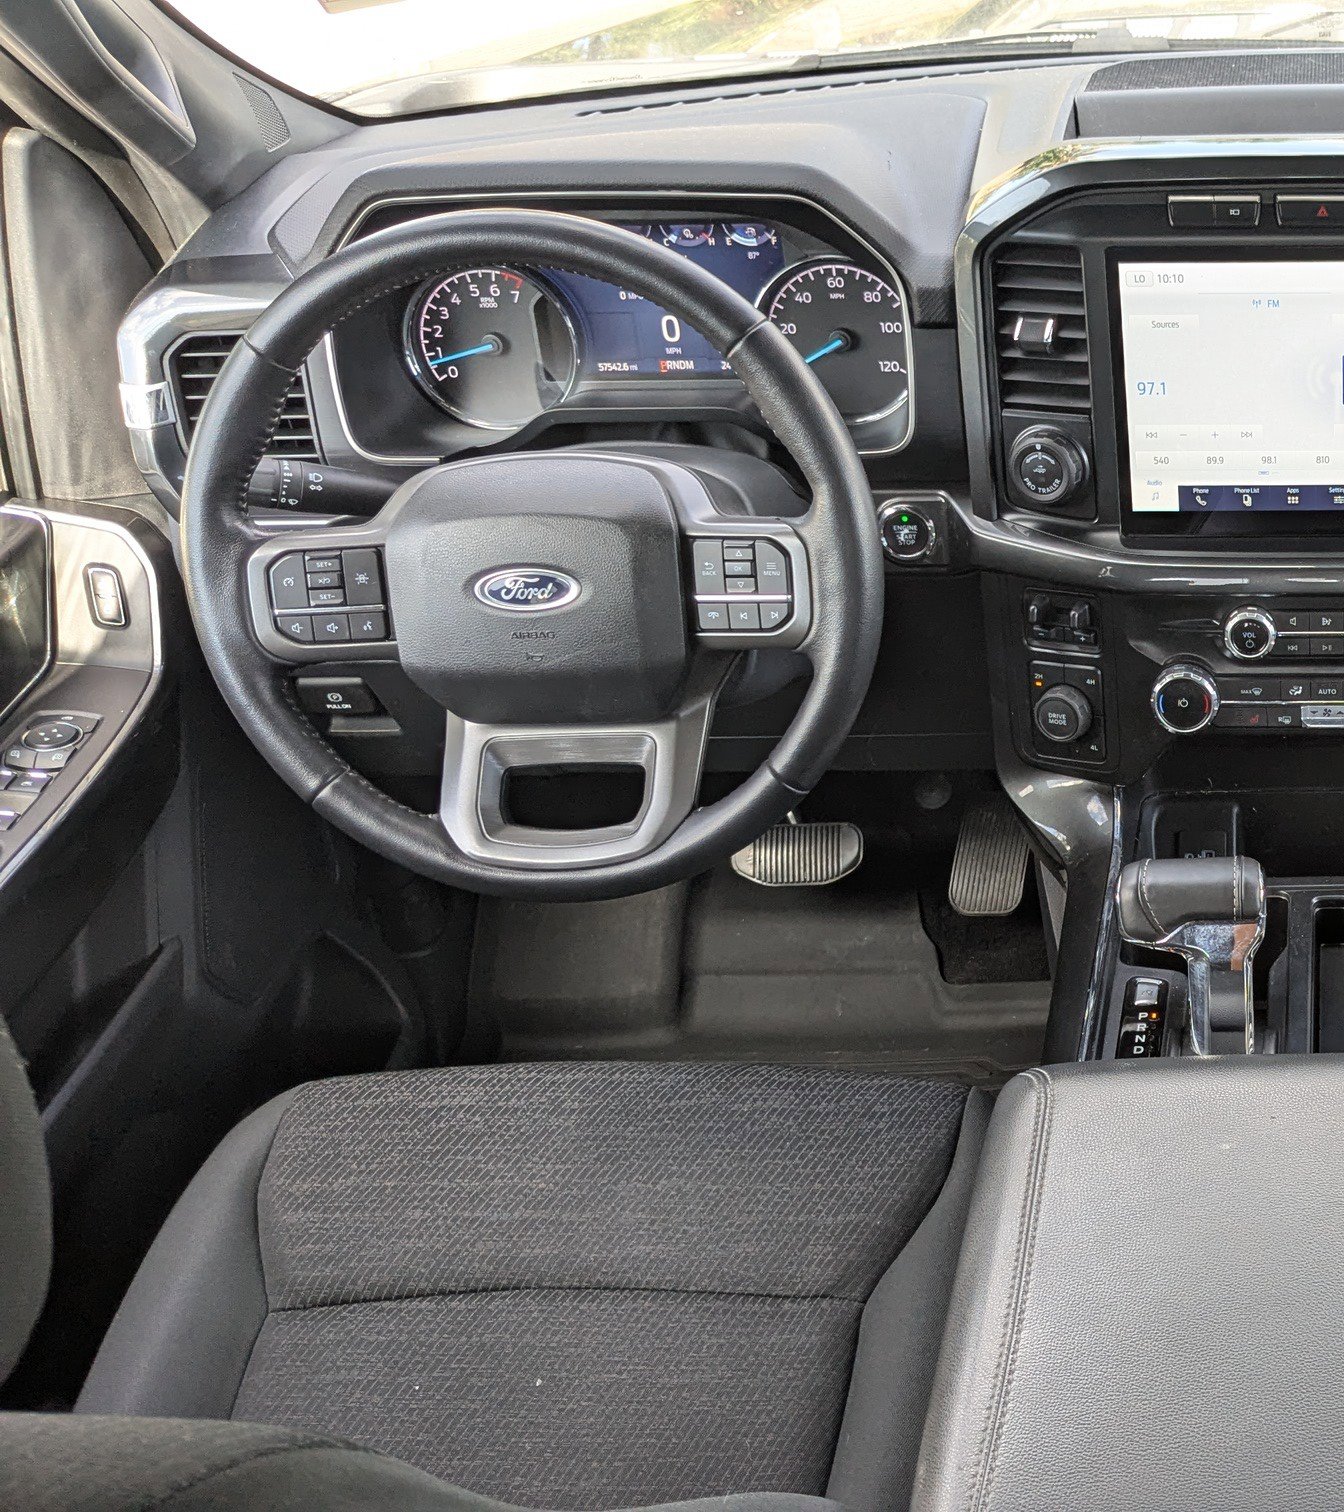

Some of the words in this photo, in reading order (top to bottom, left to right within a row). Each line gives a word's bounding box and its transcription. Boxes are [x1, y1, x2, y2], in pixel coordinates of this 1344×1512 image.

[708, 238, 716, 246] H
[726, 238, 732, 246] E
[770, 237, 777, 246] F
[827, 277, 844, 288] 60
[1134, 274, 1146, 284] LO
[1157, 274, 1184, 284] 10:10
[469, 285, 480, 297] 5
[490, 285, 500, 297] 6
[451, 294, 462, 306] 4
[510, 291, 520, 304] 7
[795, 292, 812, 304] 40
[863, 292, 882, 303] 80
[1267, 300, 1280, 308] FM
[439, 307, 450, 319] 3
[661, 314, 681, 342] 0
[780, 323, 797, 335] 20
[879, 322, 902, 334] 100
[1151, 320, 1180, 329] Sources
[433, 326, 444, 337] 2
[436, 347, 443, 358] 1
[666, 347, 682, 355] MPH
[448, 366, 459, 378] 0
[598, 362, 629, 372] 57542.6
[878, 361, 900, 373] 120
[1137, 382, 1167, 396] 97.1
[1153, 456, 1170, 465] 540
[1206, 456, 1224, 465] 89.9
[1261, 456, 1278, 464] 98.1
[1024, 477, 1036, 490] PRO
[1038, 478, 1061, 494] TRAILER
[500, 576, 554, 600] Ford
[511, 631, 556, 640] AIRBAG
[1134, 1034, 1146, 1042] N
[1133, 1046, 1144, 1054] D
